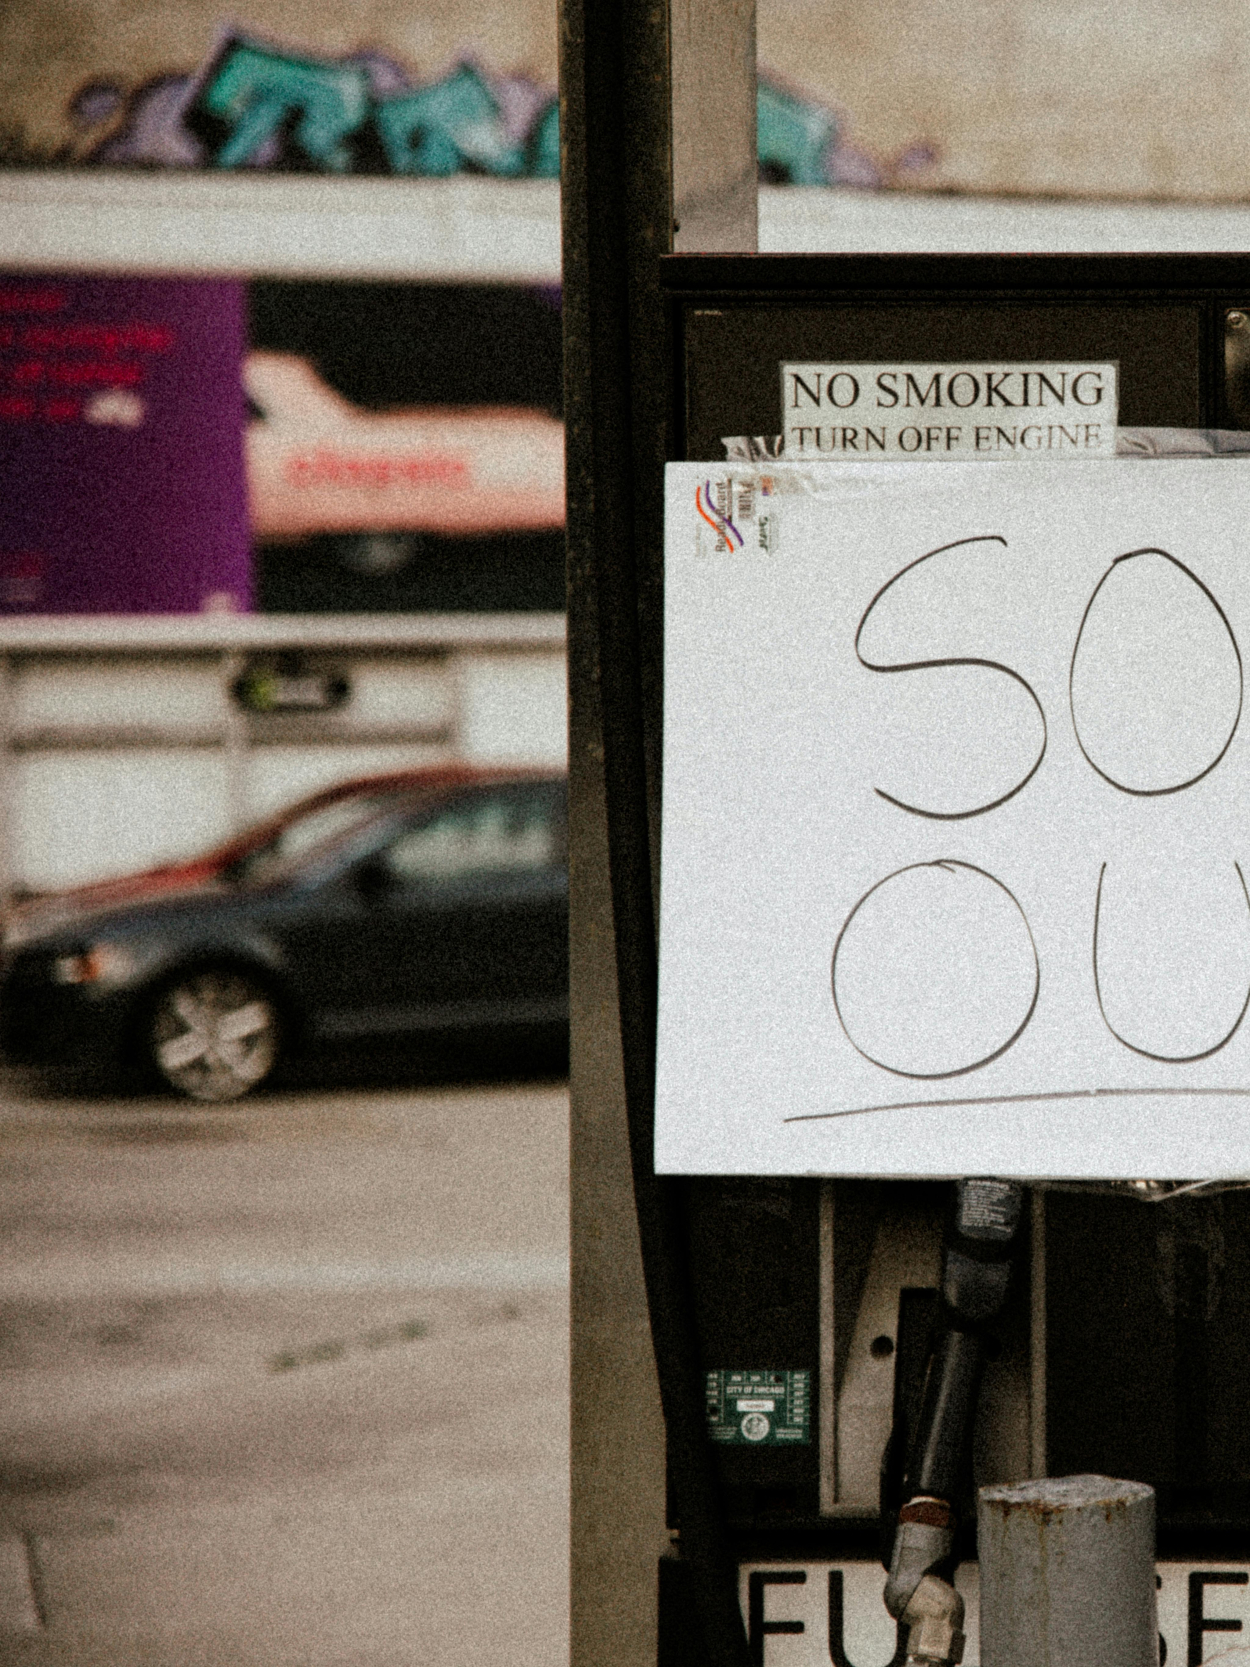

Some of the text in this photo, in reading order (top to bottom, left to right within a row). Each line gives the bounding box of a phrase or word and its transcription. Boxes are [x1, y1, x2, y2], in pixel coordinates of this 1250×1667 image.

[790, 371, 1104, 408] NO SMOKING
[791, 424, 1102, 452] TURN OFF ENGINE
[726, 1385, 742, 1395] CITY
[743, 1385, 753, 1395] OF
